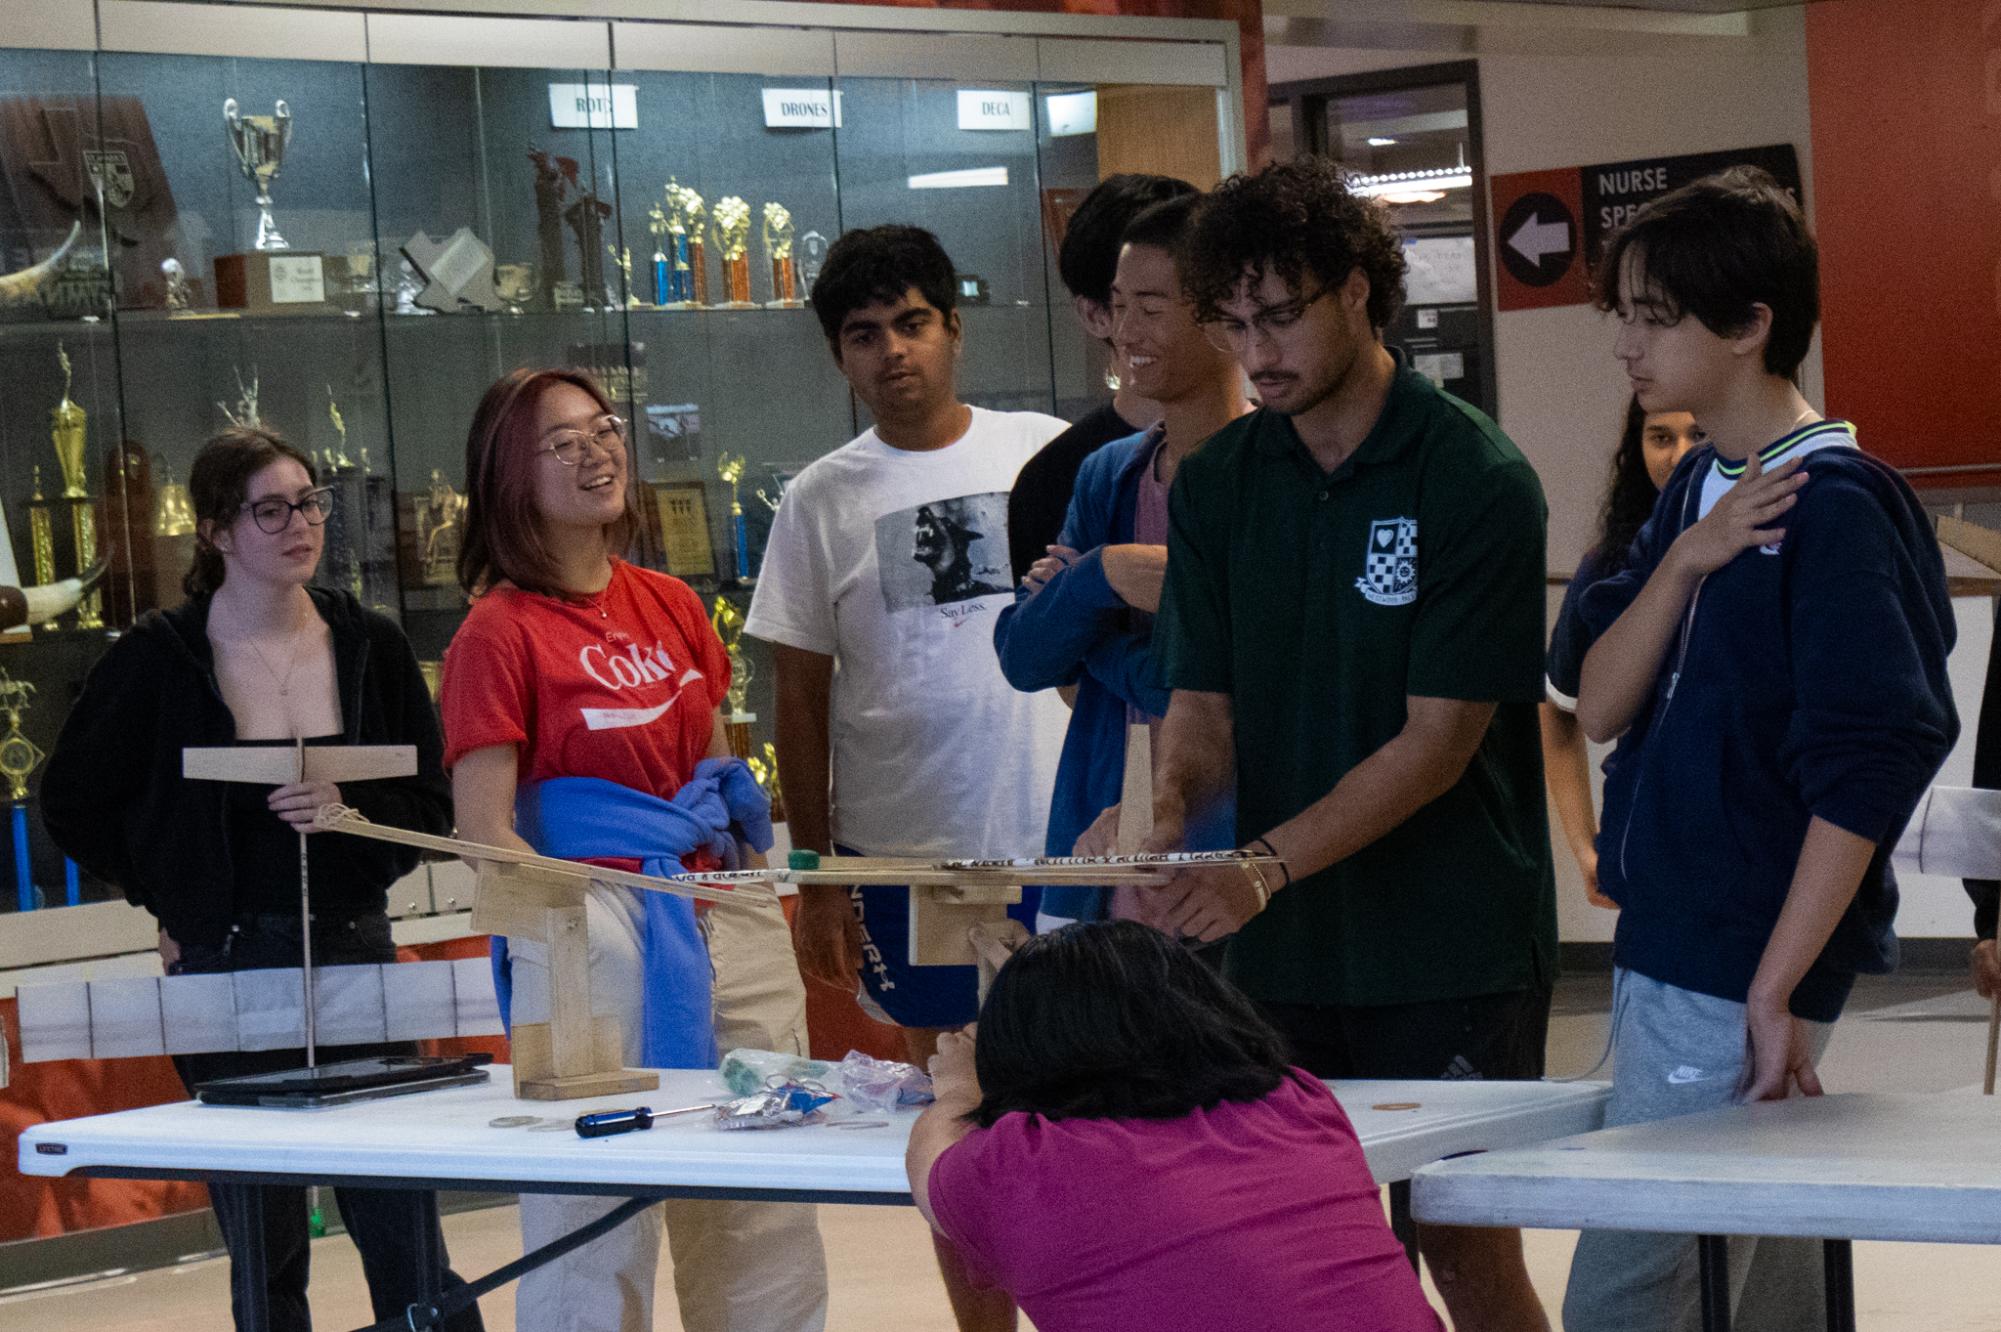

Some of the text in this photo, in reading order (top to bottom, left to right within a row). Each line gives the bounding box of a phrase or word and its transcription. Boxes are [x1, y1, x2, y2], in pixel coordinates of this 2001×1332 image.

[781, 102, 828, 117] DRONES
[982, 102, 1010, 116] DECA
[1600, 167, 1668, 196] NURSE
[940, 604, 987, 619] Say Less
